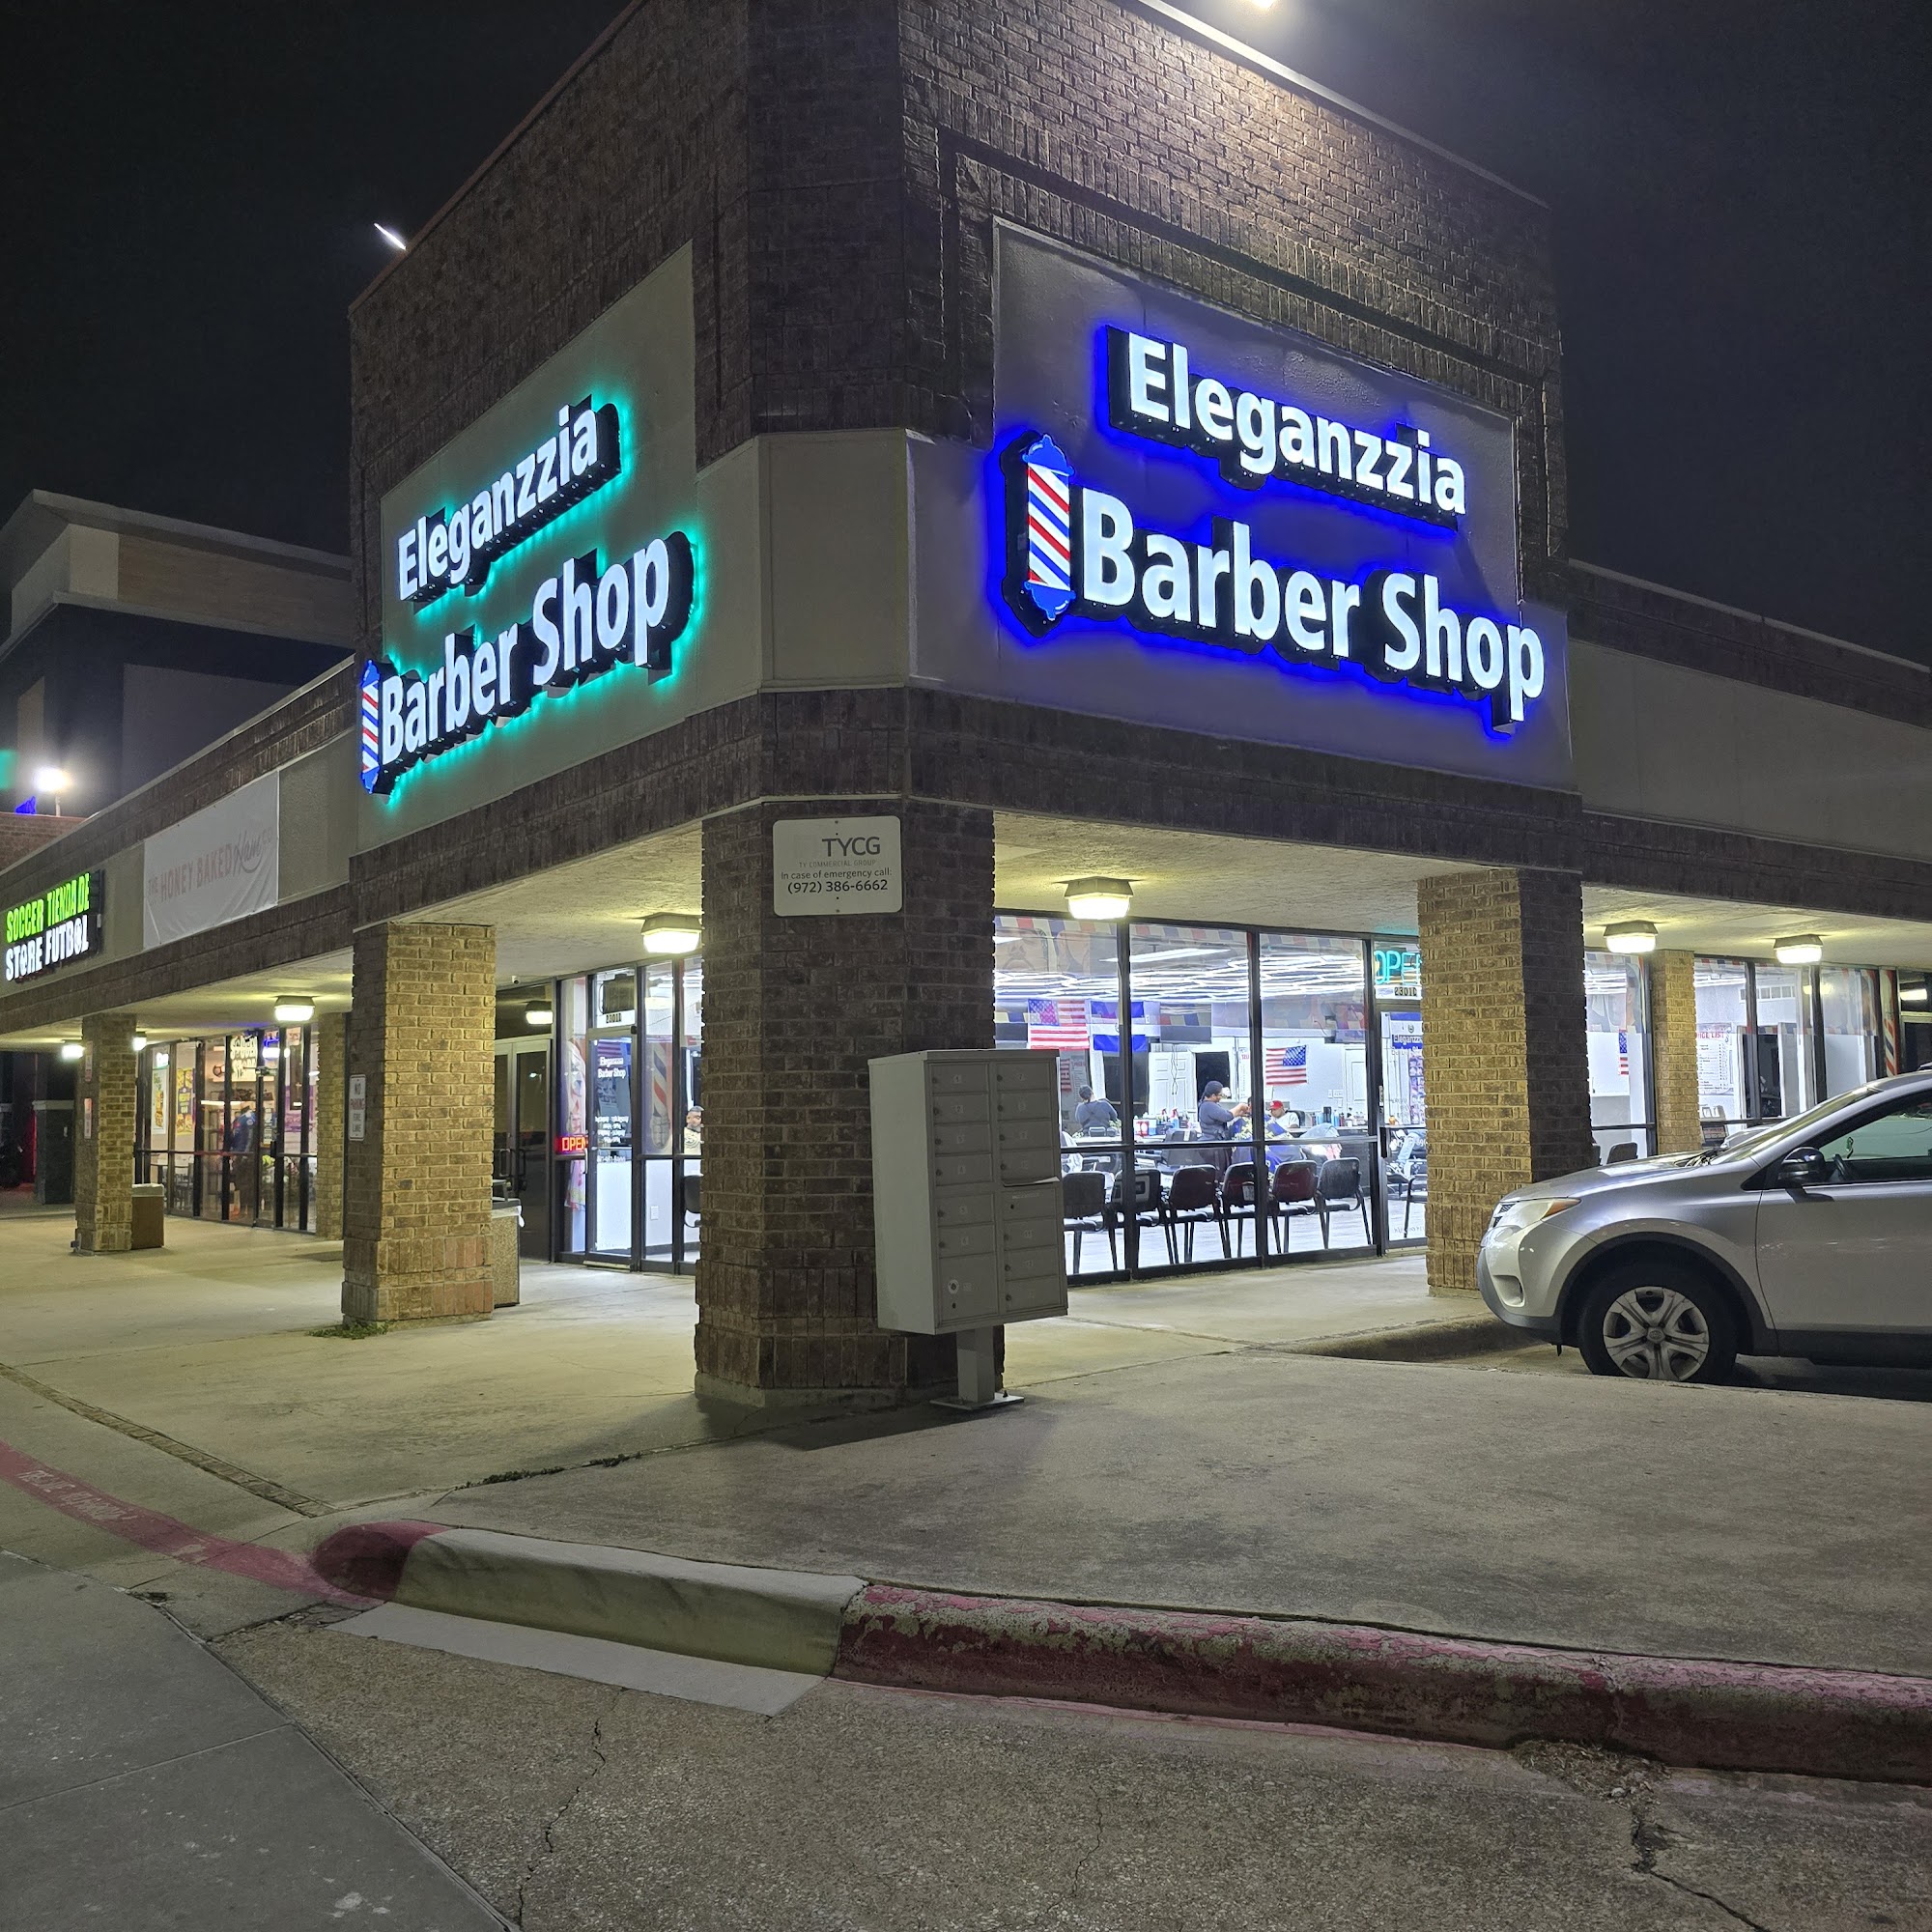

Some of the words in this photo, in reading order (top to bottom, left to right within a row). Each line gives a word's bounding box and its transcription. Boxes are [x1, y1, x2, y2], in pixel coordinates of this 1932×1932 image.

[1127, 331, 1466, 515] Eleganzzia
[398, 404, 599, 601] Eleganzzia
[1082, 486, 1361, 660] Barber
[1382, 572, 1545, 723] Shop
[382, 622, 519, 766] Barber
[532, 537, 669, 686] Shop
[160, 861, 193, 902] HONEY
[196, 843, 233, 889] BAKED
[781, 871, 789, 880] In
[790, 871, 810, 880] case
[823, 870, 872, 880] emergency
[874, 867, 893, 876] call:
[809, 860, 851, 868] COMMERCIAL
[821, 836, 881, 858] TYCG
[6, 898, 44, 943] SOCCER
[46, 879, 77, 927] TIENDA
[77, 872, 90, 914] DE
[787, 881, 822, 895] (972)
[825, 879, 888, 892] 386-6662
[6, 936, 43, 981] STORE
[44, 914, 90, 965] FUTBOL
[1393, 1035, 1422, 1045] Eleganzz
